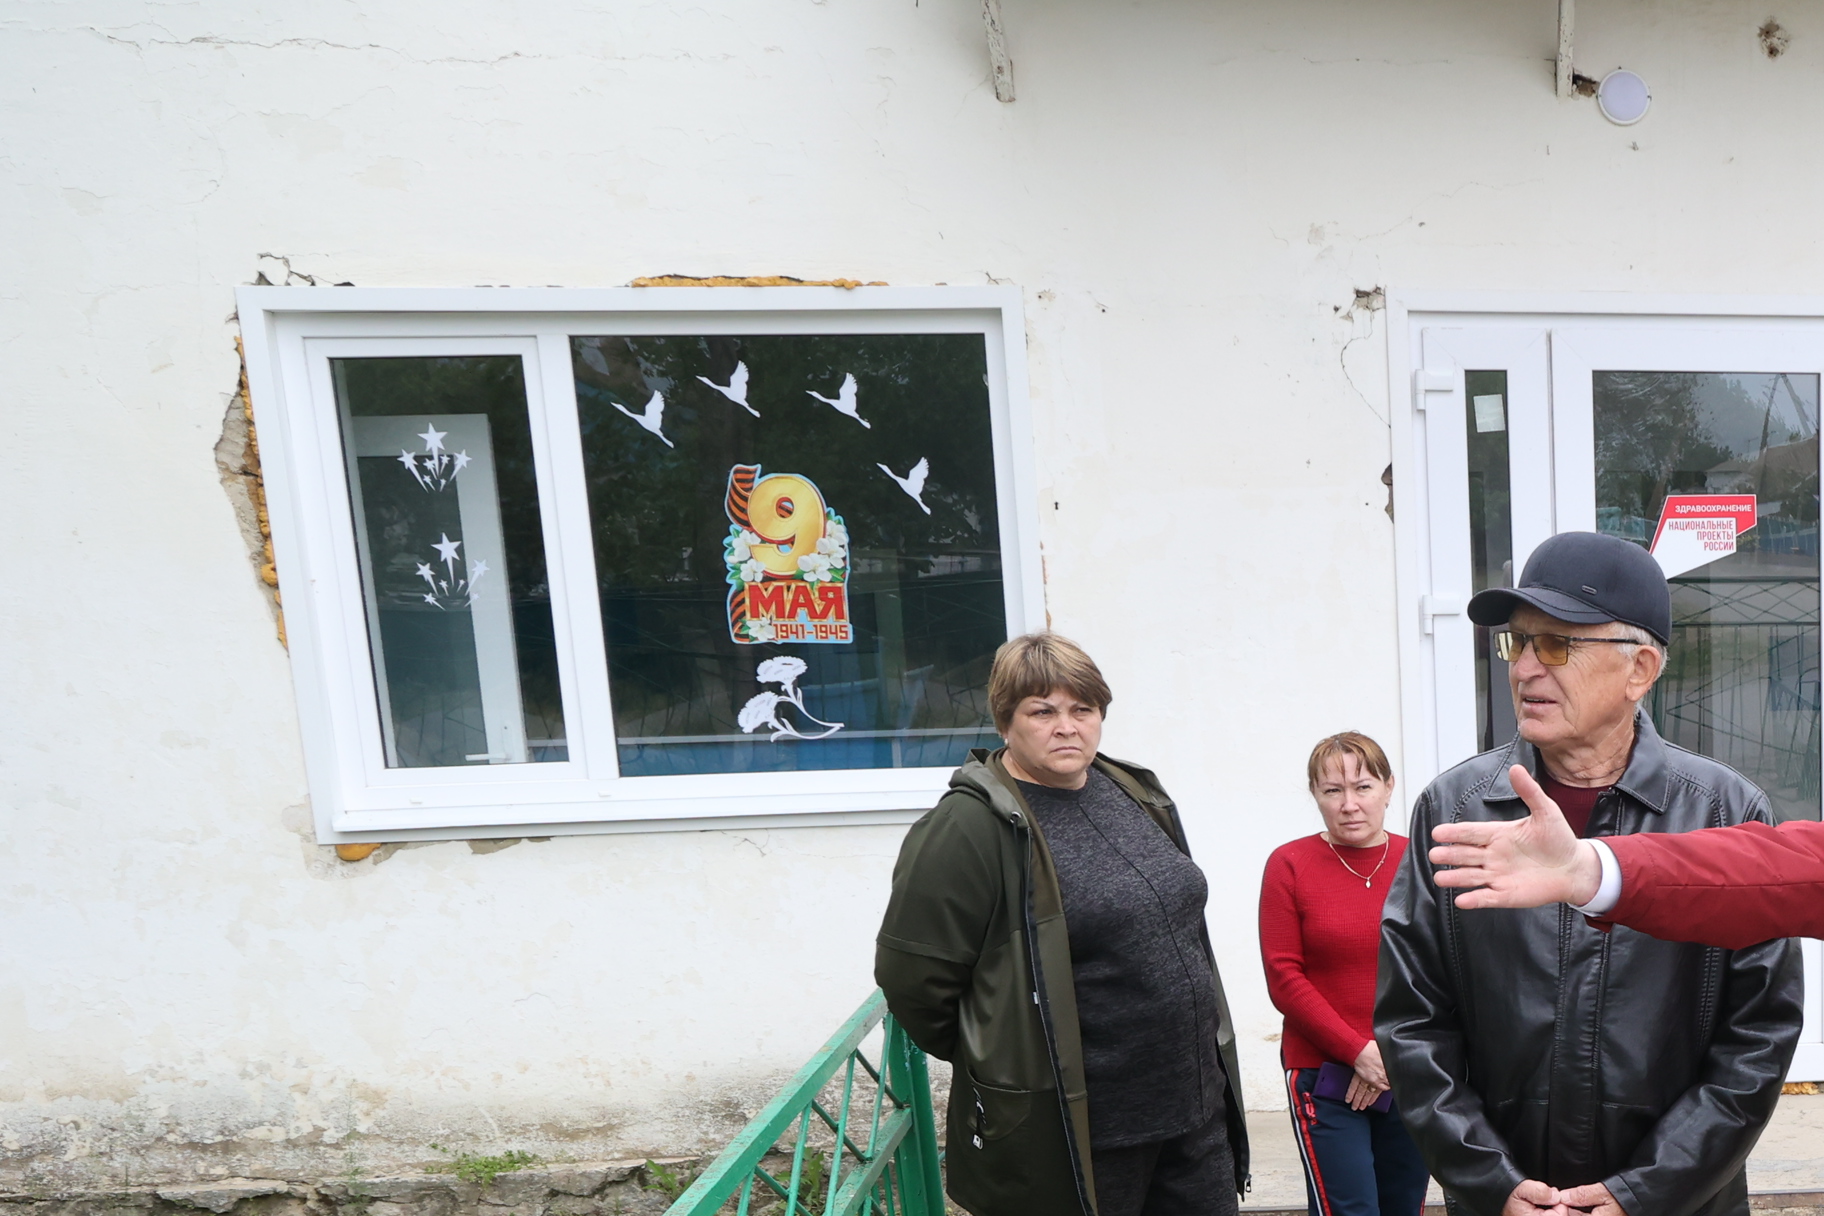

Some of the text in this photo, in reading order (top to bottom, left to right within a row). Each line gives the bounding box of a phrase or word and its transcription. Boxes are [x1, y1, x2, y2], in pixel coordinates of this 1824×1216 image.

[1675, 504, 1752, 514] ЗДРАВООХРАНЕНИЕ
[747, 474, 826, 578] 9
[1668, 520, 1734, 531] НАЦИОНАЛЬНЫЕ
[1696, 531, 1734, 541] ПРОЕКТЫ
[1704, 541, 1734, 551] РОССИИ
[745, 582, 847, 621] МАЯ
[773, 623, 849, 640] 1941-1945
